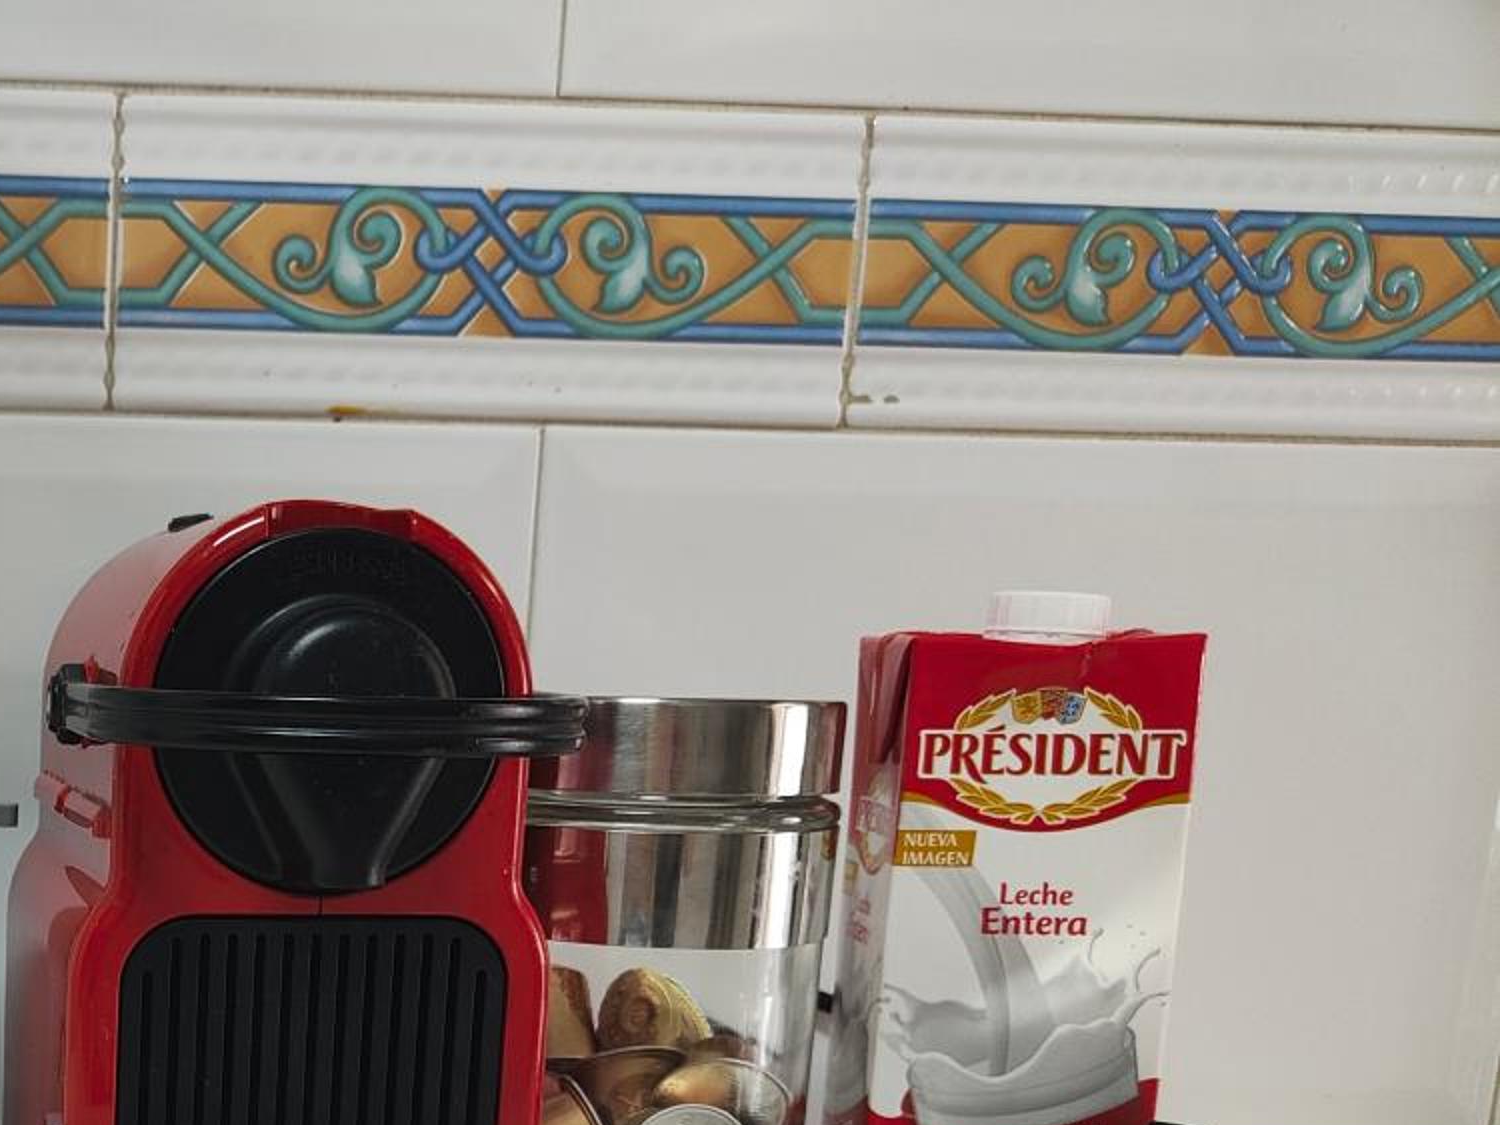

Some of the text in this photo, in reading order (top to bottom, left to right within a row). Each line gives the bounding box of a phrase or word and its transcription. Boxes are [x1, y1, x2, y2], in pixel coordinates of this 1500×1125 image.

[921, 725, 1184, 784] PRÉSIDENT
[903, 832, 958, 847] NUEVA
[901, 851, 969, 865] IMAGEN
[1000, 881, 1073, 906] Leche
[981, 906, 1088, 936] Entera
